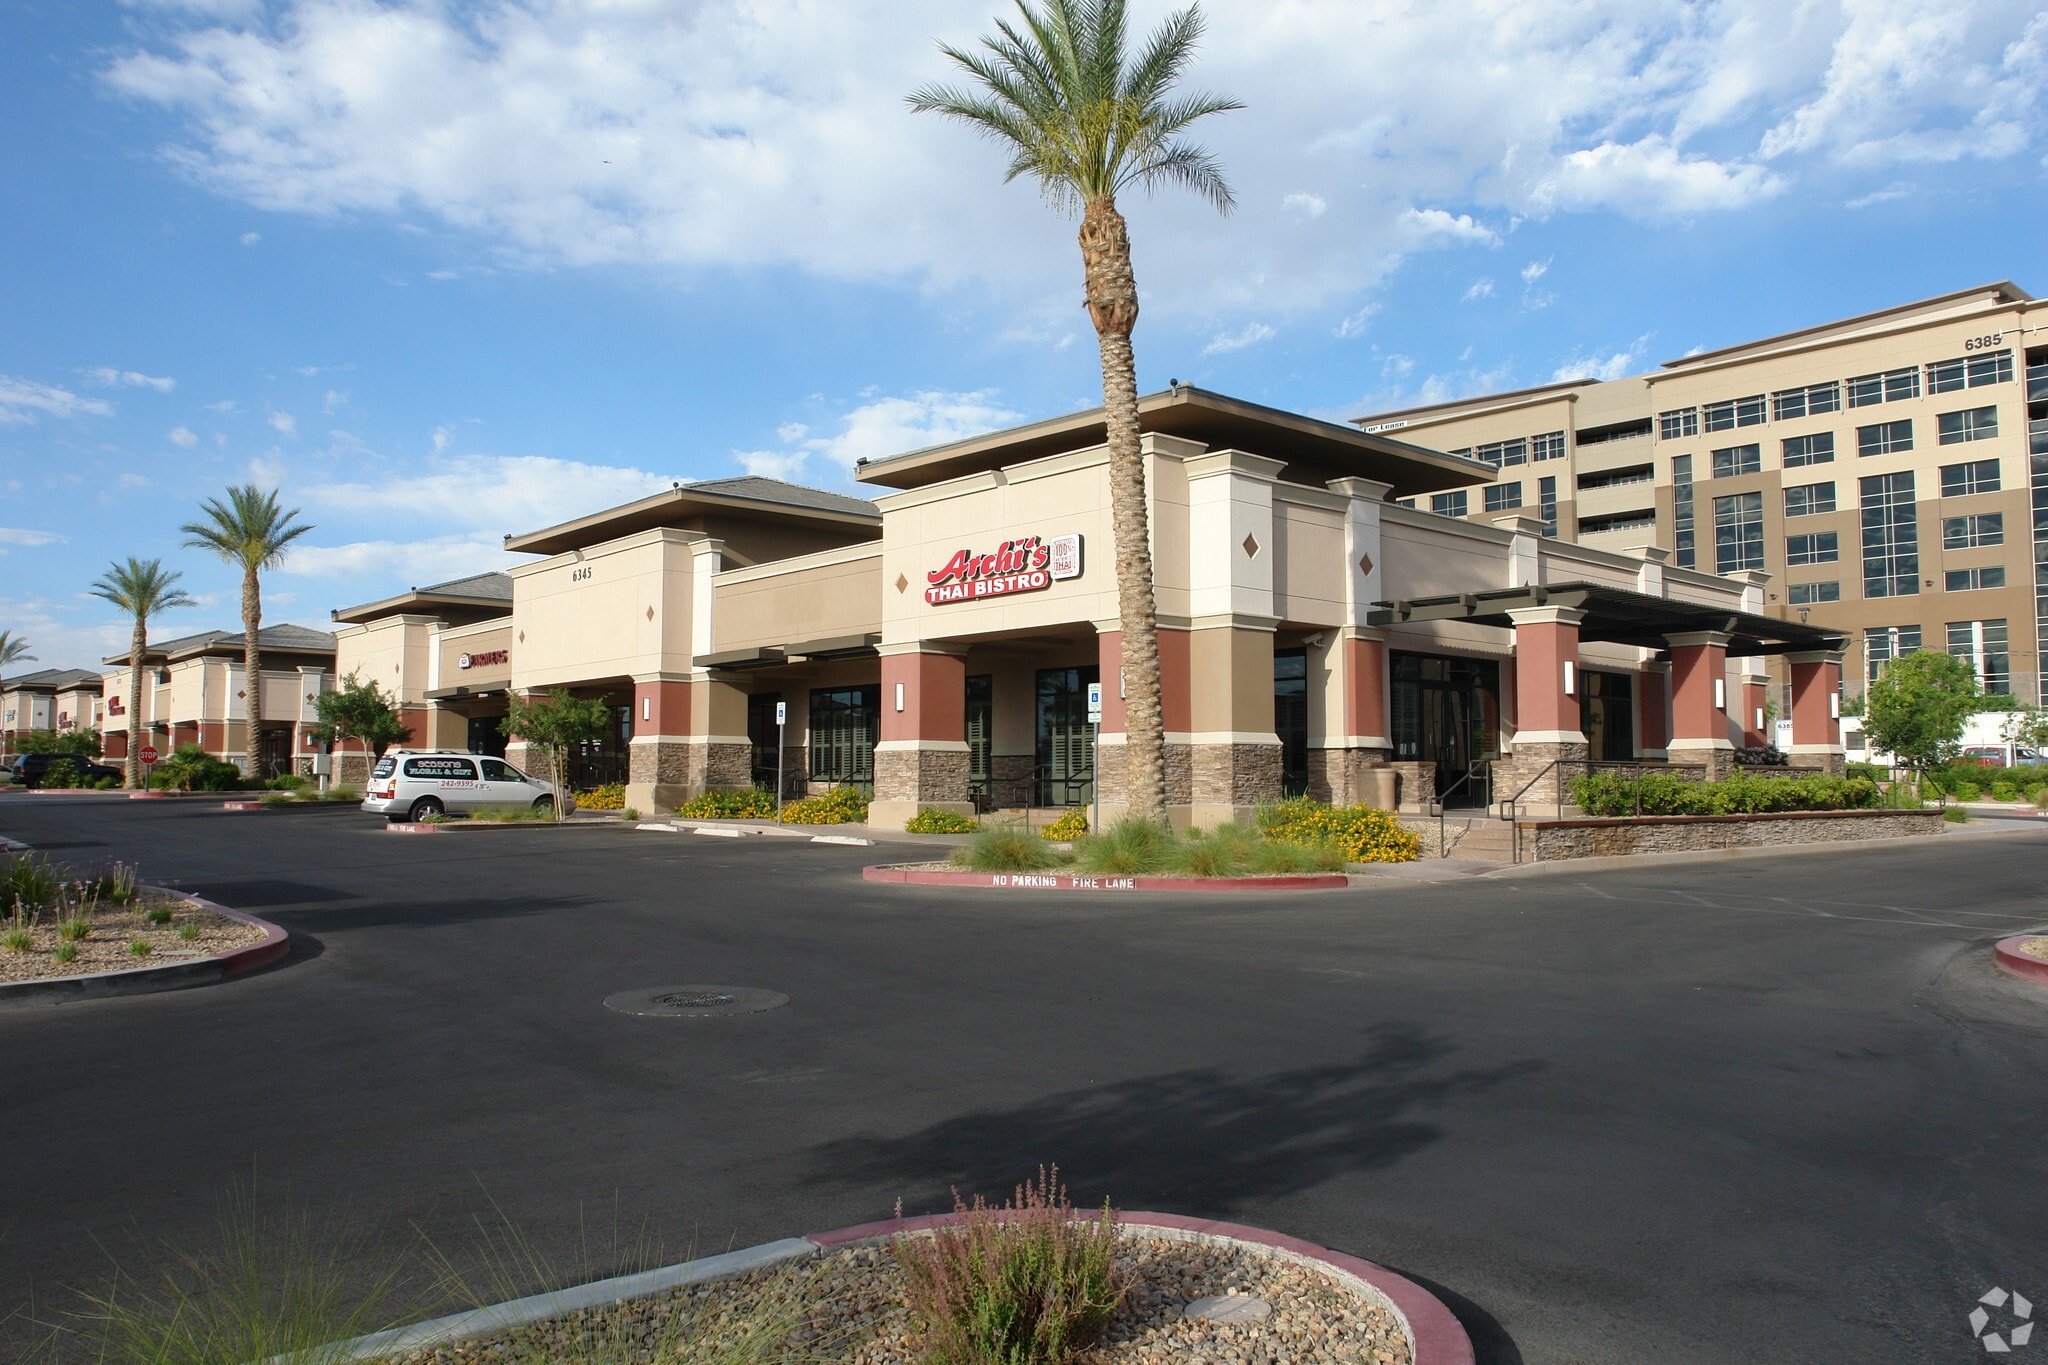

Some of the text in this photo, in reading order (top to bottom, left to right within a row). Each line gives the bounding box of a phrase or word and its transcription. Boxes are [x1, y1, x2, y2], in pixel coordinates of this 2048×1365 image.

[1965, 333, 2003, 351] 6385
[927, 536, 1048, 583] Archi's
[572, 566, 592, 582] 6345
[927, 572, 1045, 602] THAI BISTRO
[140, 751, 157, 759] STOP
[452, 768, 472, 776] GIFT
[992, 875, 1135, 889] NO PARKING FIRE LANE
